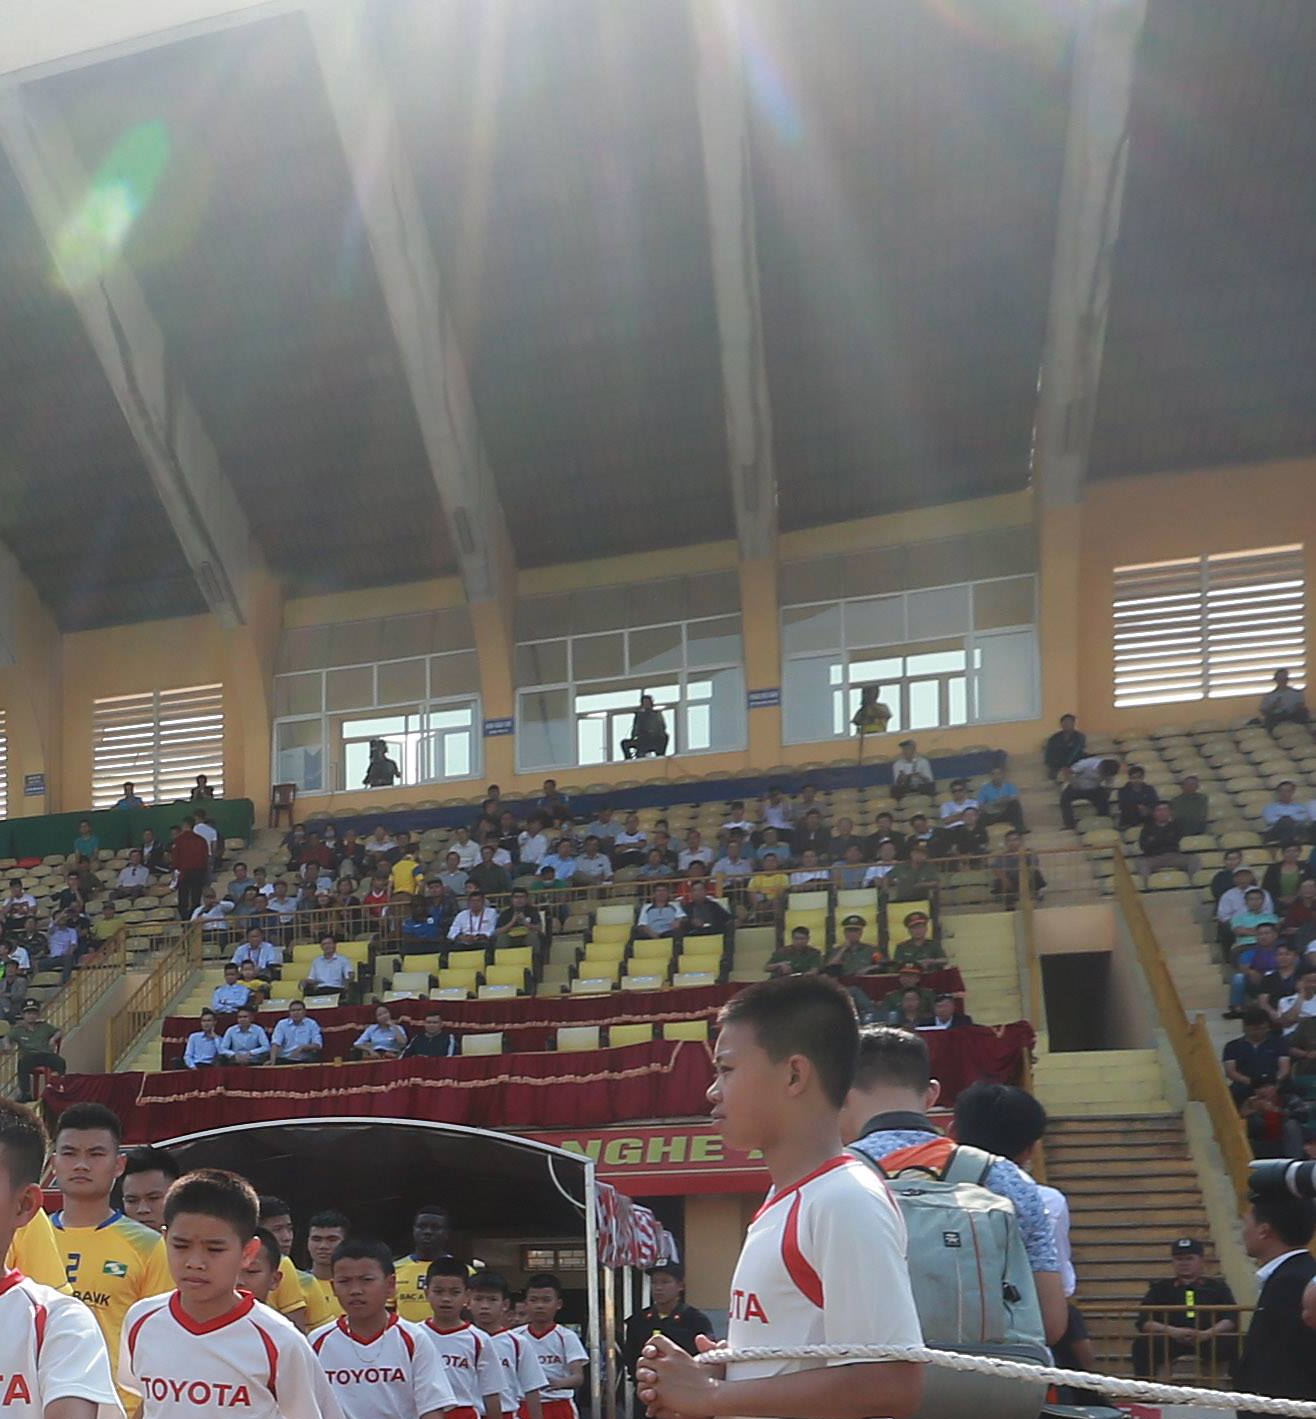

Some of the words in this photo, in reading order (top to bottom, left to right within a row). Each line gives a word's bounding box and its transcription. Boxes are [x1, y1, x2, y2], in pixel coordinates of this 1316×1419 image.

[66, 1252, 81, 1283] 2
[140, 1376, 252, 1407] TOYOTA
[324, 1367, 406, 1385] TOYOTA
